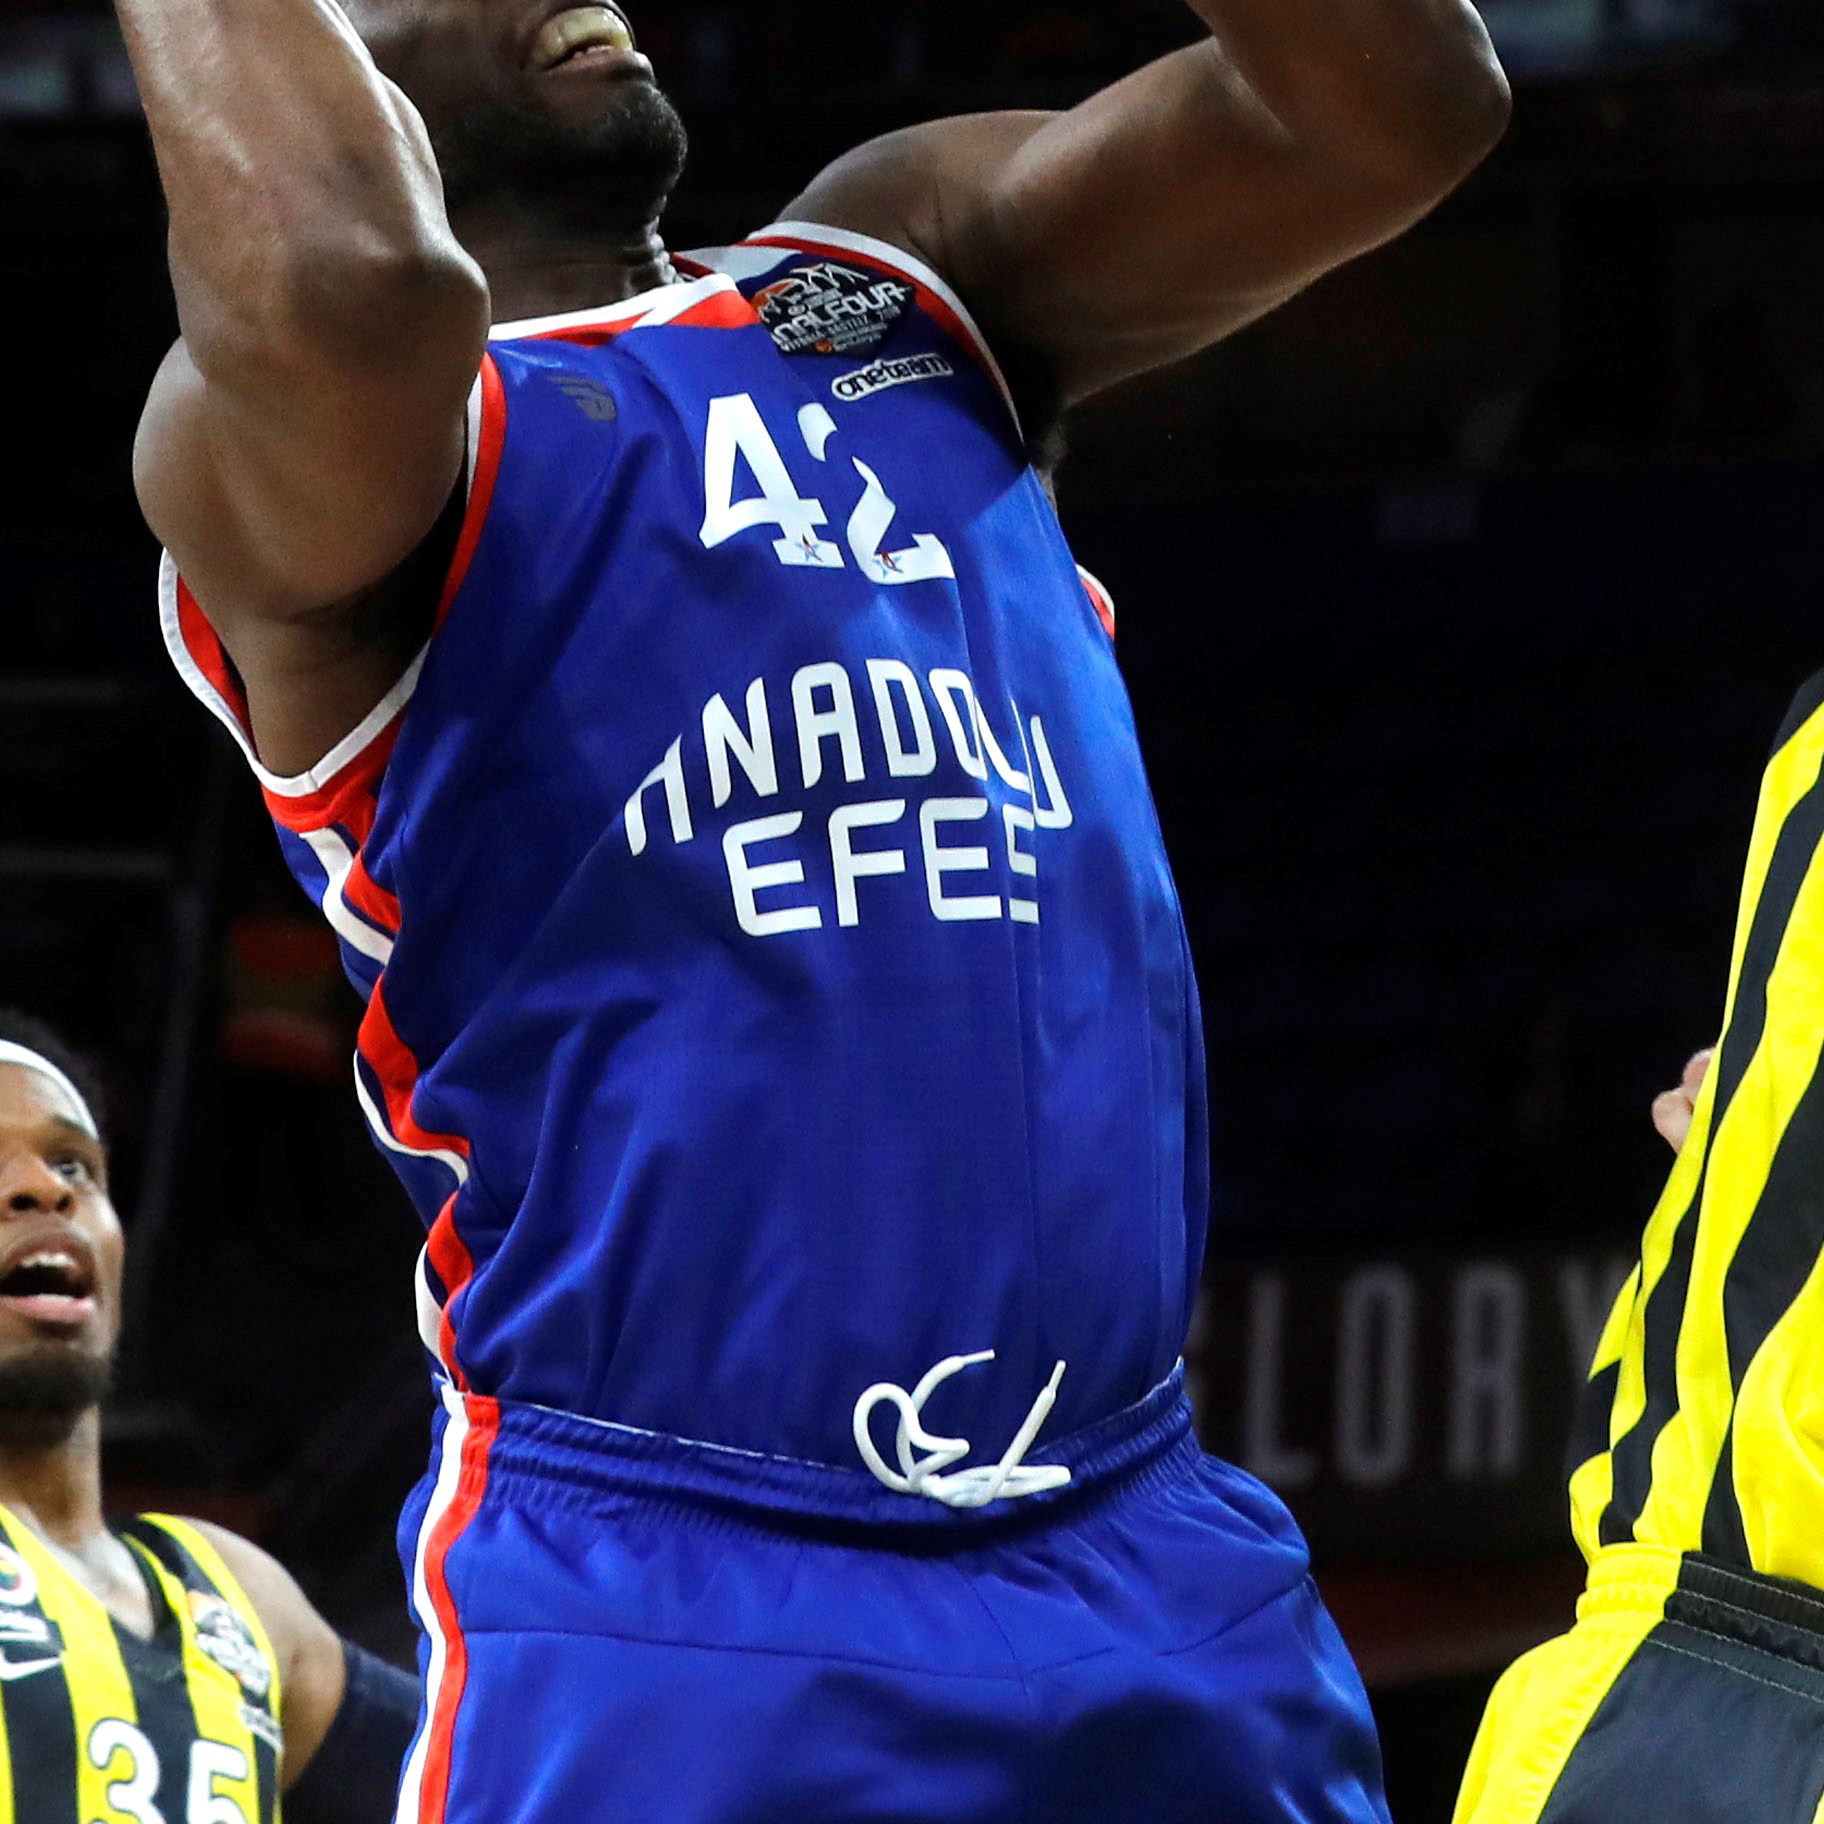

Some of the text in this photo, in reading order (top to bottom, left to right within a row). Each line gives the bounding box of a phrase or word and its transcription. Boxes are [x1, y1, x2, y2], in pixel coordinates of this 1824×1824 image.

[699, 392, 956, 585] 42
[624, 658, 1073, 856] ANADOLU
[722, 797, 1039, 937] EFES
[1182, 1254, 1640, 1485] LORY
[88, 1717, 250, 1824] 35
